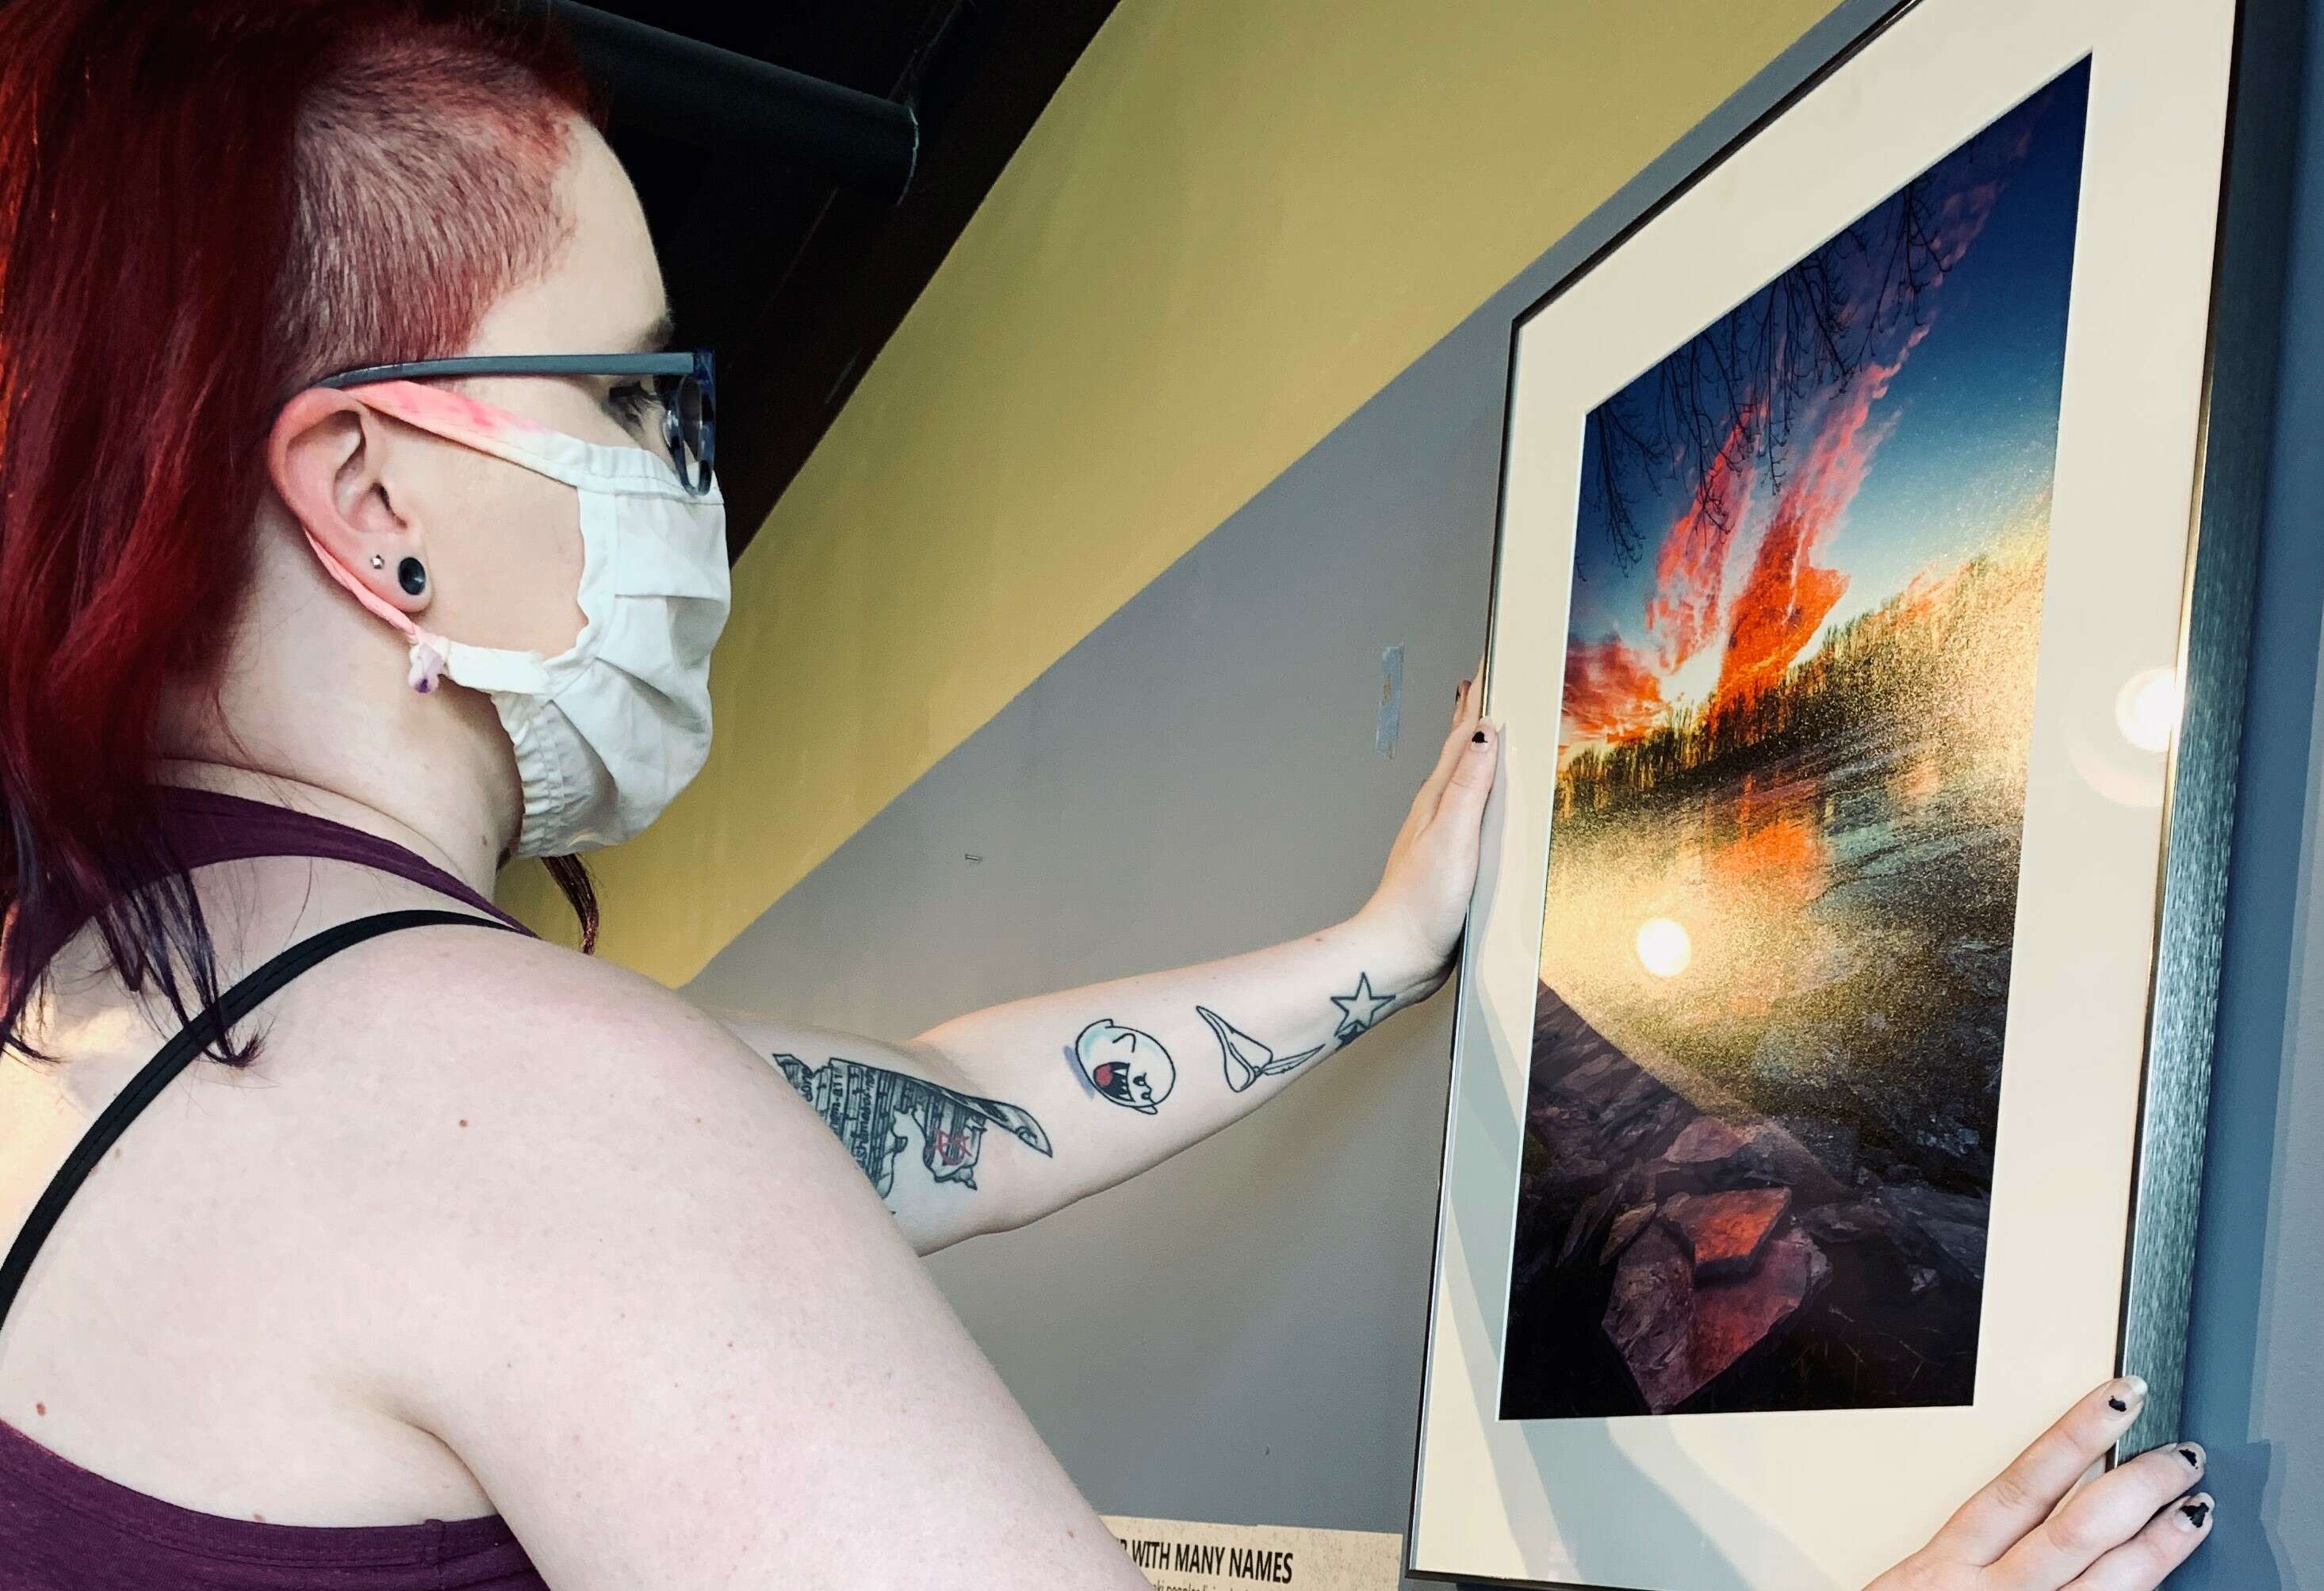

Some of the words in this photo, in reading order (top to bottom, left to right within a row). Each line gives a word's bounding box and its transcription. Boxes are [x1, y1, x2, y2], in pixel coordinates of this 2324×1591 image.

[1131, 1539, 1170, 1570] WITH
[1174, 1543, 1226, 1576] MANY
[1228, 1547, 1294, 1584] NAMES
